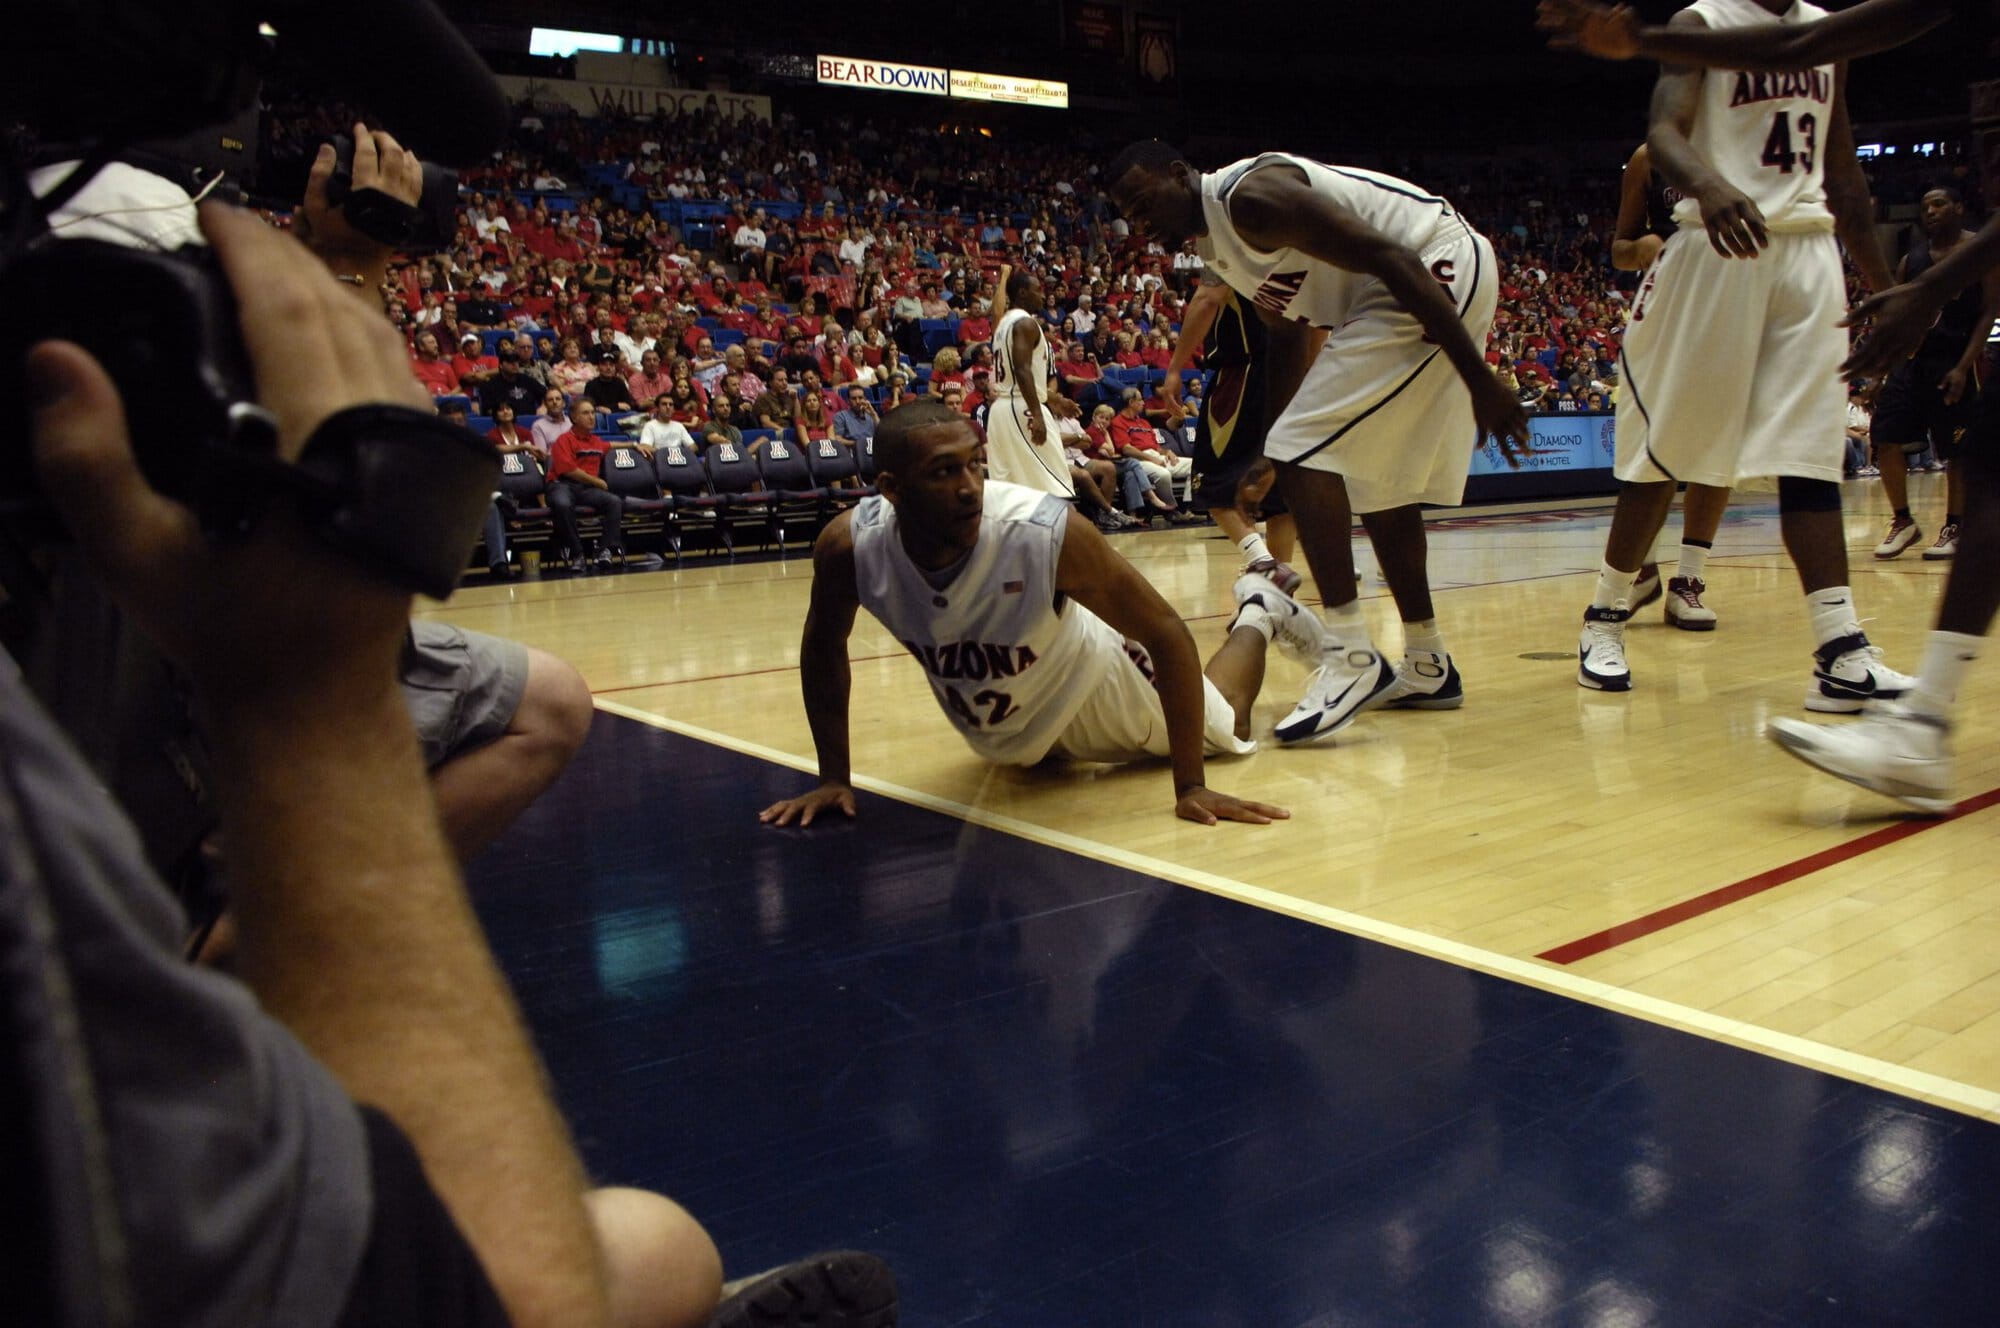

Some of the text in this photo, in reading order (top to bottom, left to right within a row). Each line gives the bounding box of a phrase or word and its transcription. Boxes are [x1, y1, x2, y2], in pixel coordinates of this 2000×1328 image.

[1761, 111, 1815, 174] 43
[1534, 432, 1582, 447] DIAMOND
[1546, 456, 1571, 465] HOTEL
